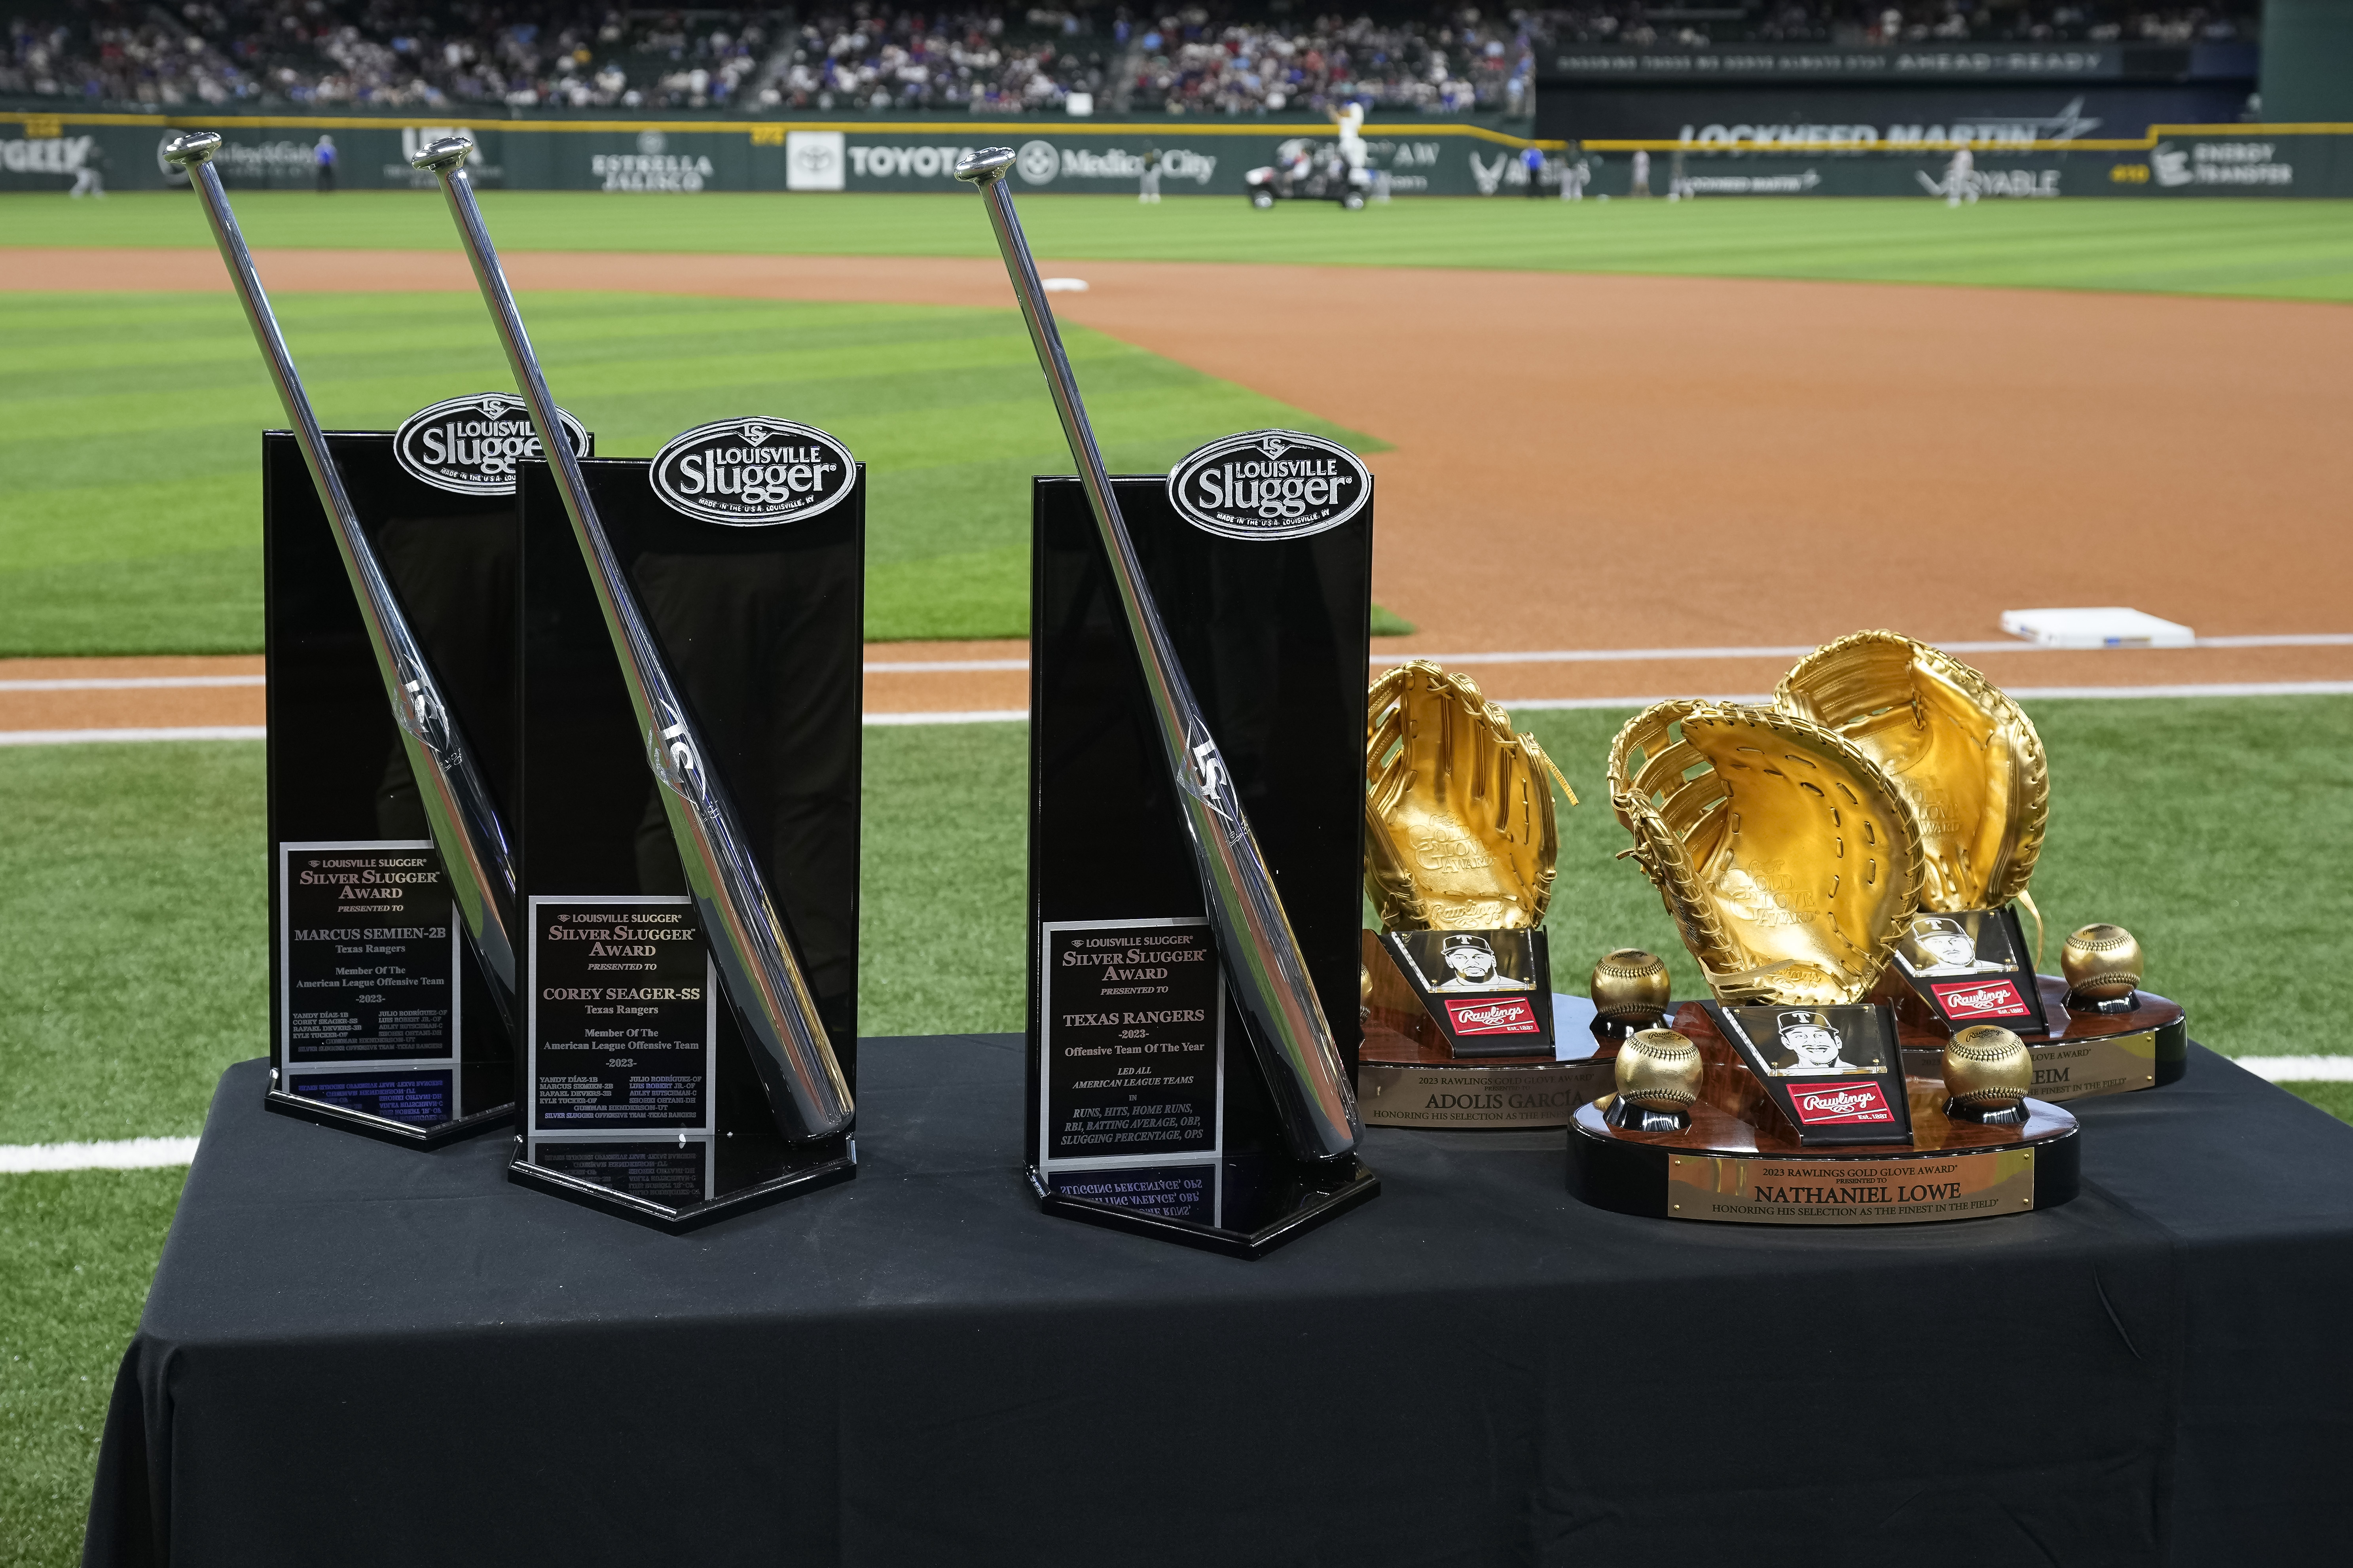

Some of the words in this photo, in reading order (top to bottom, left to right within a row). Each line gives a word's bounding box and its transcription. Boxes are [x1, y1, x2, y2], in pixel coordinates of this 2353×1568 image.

[457, 421, 537, 436] LOUISVIL
[423, 422, 543, 474] Slugge
[716, 446, 821, 464] LOUISVILLE
[1236, 459, 1337, 478] LOUISVILLE
[699, 498, 716, 508] MADE
[806, 495, 814, 504] KY
[1442, 857, 1494, 873] AWARD
[300, 870, 360, 884] SILVER
[339, 886, 402, 899] AWARD
[1924, 919, 1942, 930] T
[294, 929, 360, 941] MARCUS
[364, 928, 446, 939] SEMIEN-2B
[548, 926, 611, 940] SILVER
[1086, 937, 1141, 947] LOUISVILLE
[1456, 936, 1472, 945] T
[366, 945, 405, 954] Rangers
[589, 942, 656, 956] AWARD
[1611, 951, 1648, 960] Rawlings
[1063, 951, 1124, 966] SILVER
[1102, 966, 1168, 981] AWARD
[342, 979, 374, 989] League
[543, 988, 603, 1000] COREY
[606, 988, 700, 1000] SEAGER-SS
[1100, 987, 1155, 995] PRESENTED
[1948, 990, 2011, 1007] Rawlings
[616, 1005, 658, 1015] Rangers
[1458, 1006, 1524, 1023] Rawlings
[1063, 1013, 1119, 1027] TEXAS
[1123, 1009, 1205, 1024] RANGERS
[1792, 1013, 1811, 1023] T
[1119, 1030, 1149, 1039] -2023-
[1648, 1031, 1686, 1040] Rawlings
[1966, 1028, 2005, 1042] Rawlings
[592, 1042, 625, 1051] League
[1065, 1046, 1112, 1057] Offensive
[1115, 1045, 1141, 1054] Team
[1145, 1044, 1158, 1053] Of
[1160, 1043, 1179, 1052] The
[1181, 1043, 1204, 1051] Year
[606, 1059, 637, 1067] -2023-
[2031, 1067, 2070, 1084] EIM
[1073, 1079, 1122, 1089] AMERICAN
[1124, 1078, 1161, 1087] LEAGUE
[2041, 1086, 2070, 1095] FINEST
[1425, 1094, 1503, 1109] ADOLIS
[1508, 1089, 1583, 1108] GARCÍA
[1804, 1092, 1876, 1111] Rawlings
[1073, 1108, 1101, 1118] RUNS,
[1104, 1106, 1130, 1117] HITS,
[1132, 1105, 1162, 1115] HOME
[1164, 1104, 1193, 1114] RUNS,
[1373, 1110, 1429, 1119] HONORING
[1065, 1122, 1084, 1133] RBI,
[1086, 1120, 1129, 1131] BATTING
[1130, 1117, 1178, 1129] AVERAGE,
[1180, 1117, 1200, 1127] OBP,
[1061, 1133, 1113, 1145] SLUGGING
[1114, 1131, 1182, 1142] PERCENTAGE,
[1185, 1129, 1203, 1139] OPS
[1880, 1167, 1915, 1176] GLOVE
[1754, 1186, 1892, 1204] NATHANIEL
[1898, 1182, 1961, 1202] LOWE
[1712, 1204, 1775, 1215] HONORING
[1899, 1205, 1933, 1214] FINEST
